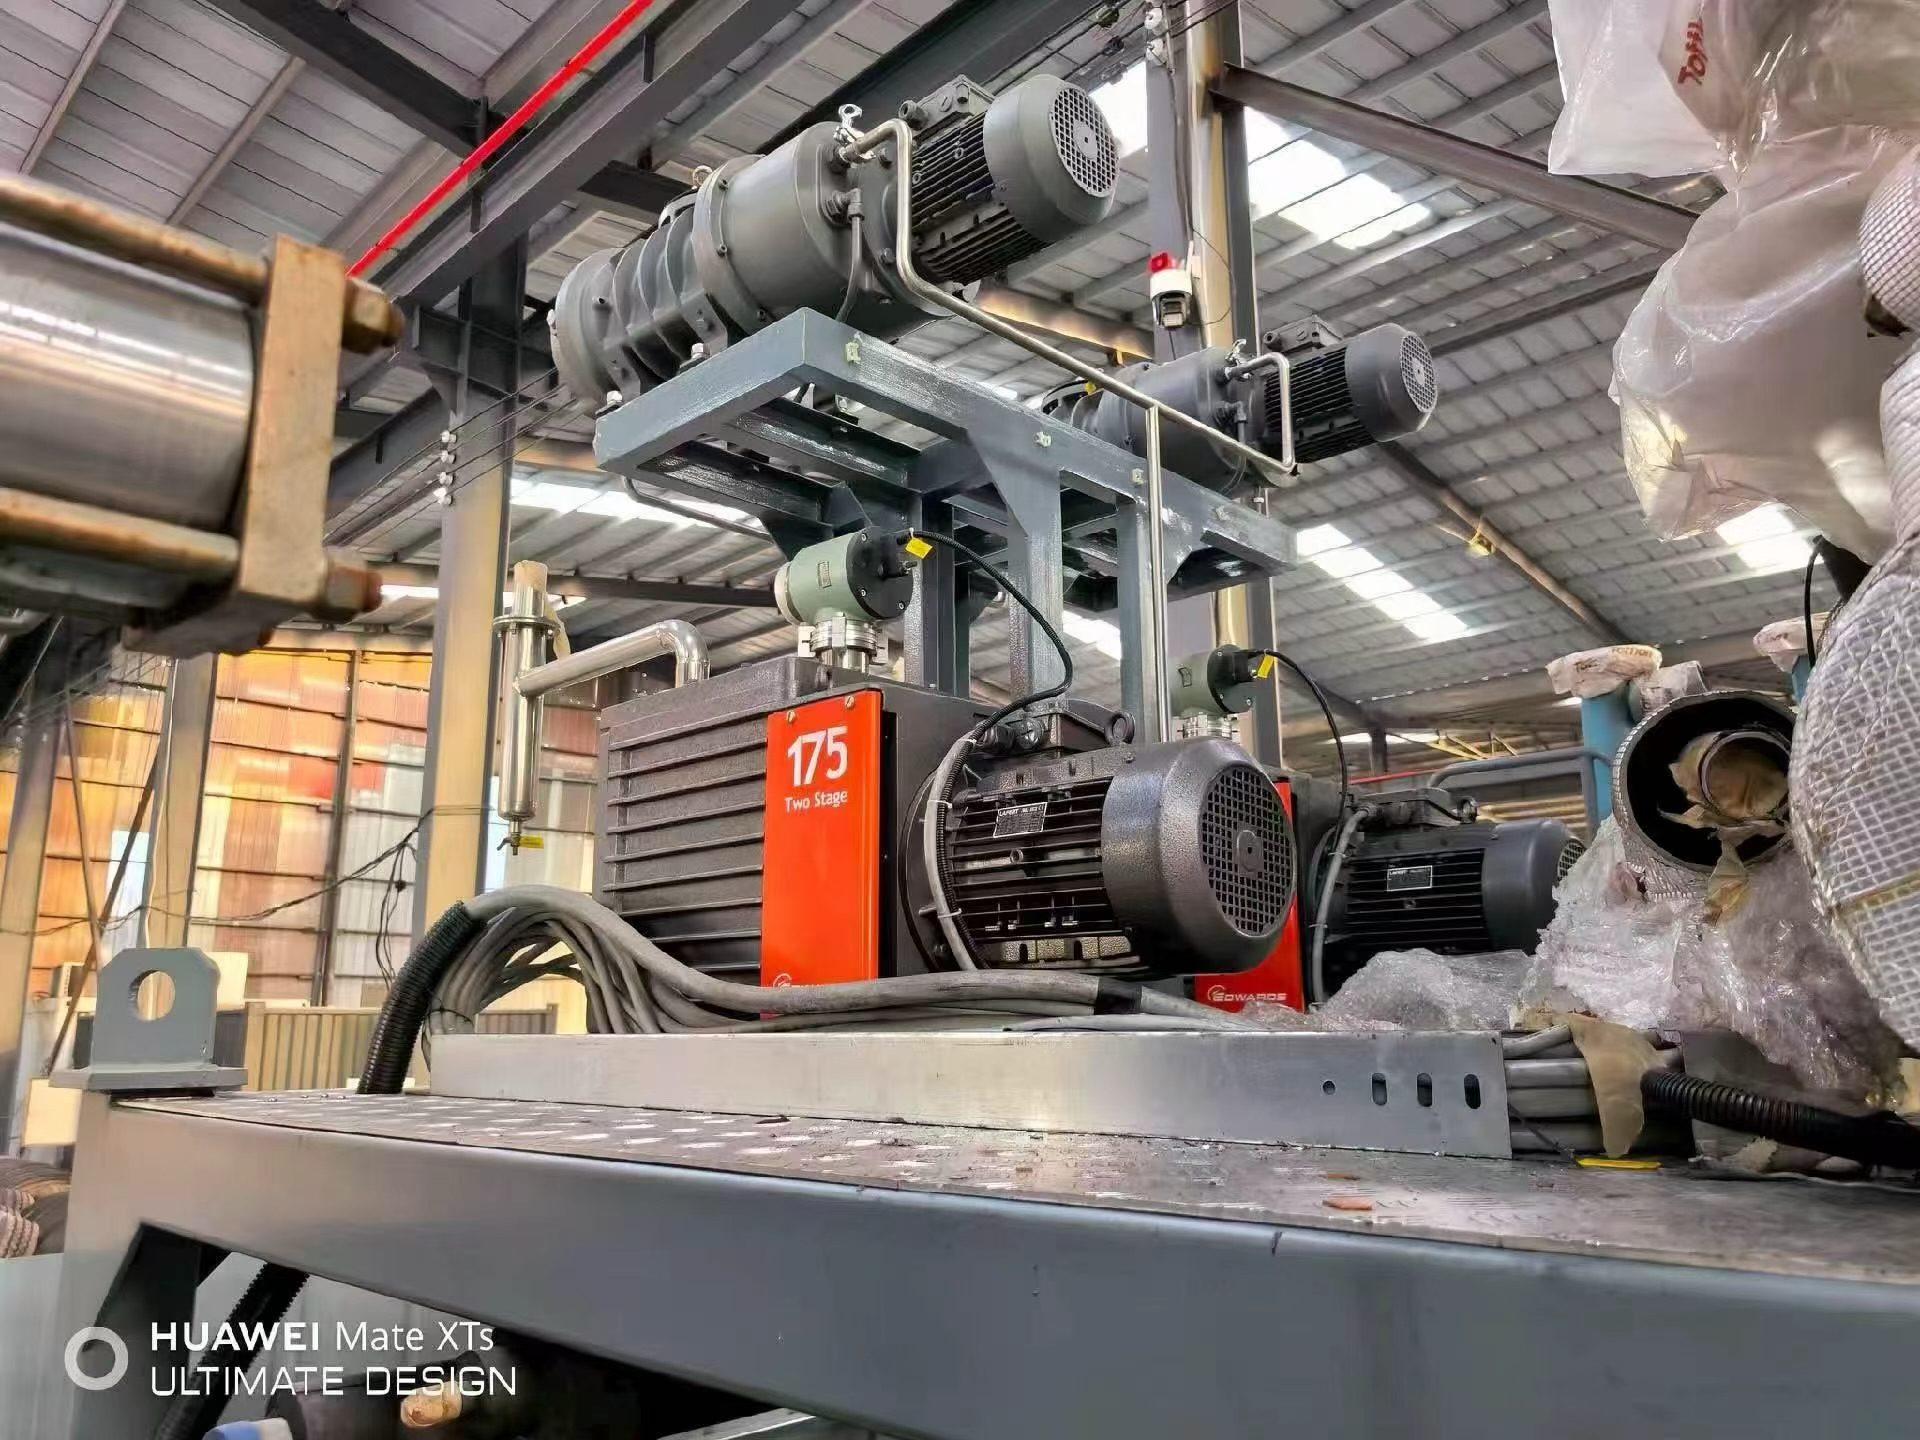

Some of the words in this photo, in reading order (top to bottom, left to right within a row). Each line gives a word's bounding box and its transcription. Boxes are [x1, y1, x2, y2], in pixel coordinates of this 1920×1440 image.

[787, 725, 848, 787] 175
[784, 797, 811, 813] Two
[814, 790, 848, 808] Stage
[1212, 992, 1287, 1002] EDWARDS
